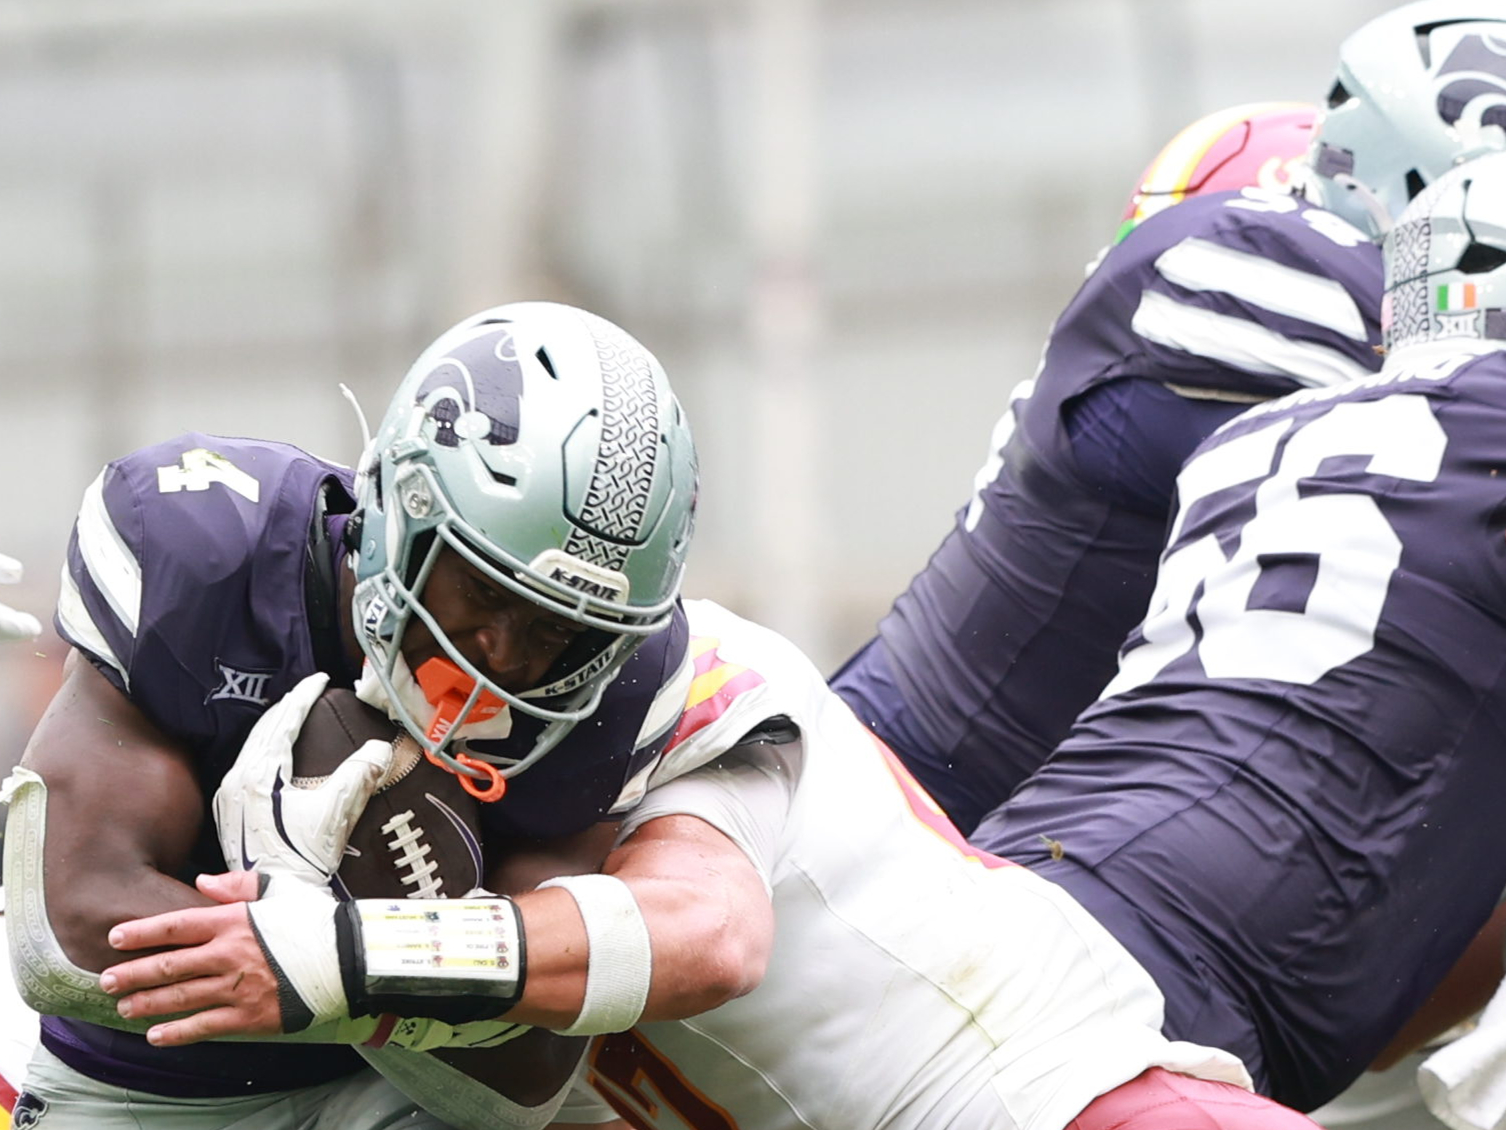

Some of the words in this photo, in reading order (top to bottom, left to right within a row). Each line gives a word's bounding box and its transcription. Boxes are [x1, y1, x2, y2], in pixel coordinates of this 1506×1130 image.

[157, 448, 260, 504] 4
[549, 566, 622, 602] K-STATE
[211, 663, 273, 706] XII
